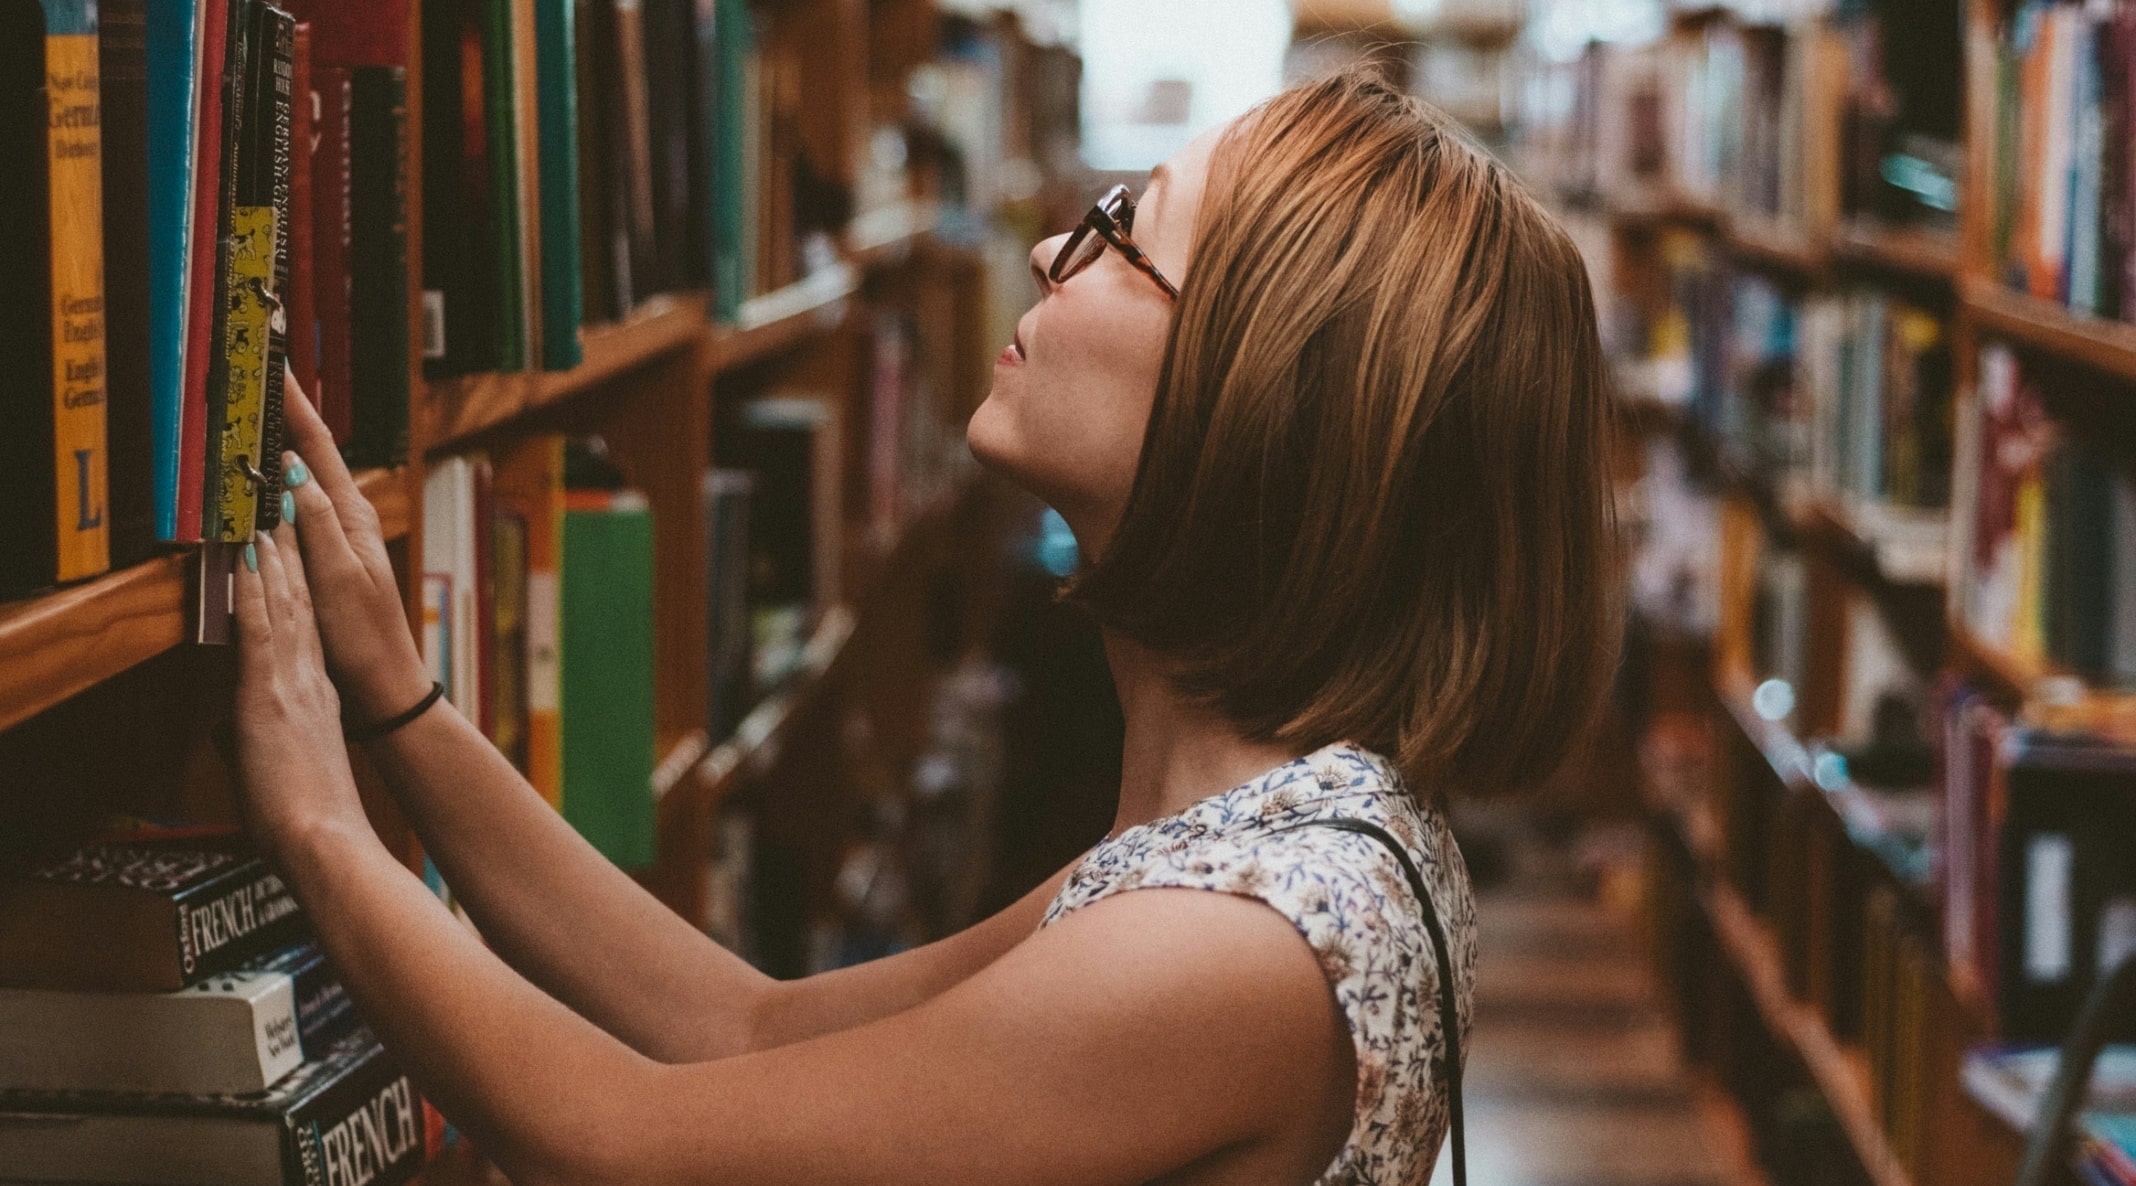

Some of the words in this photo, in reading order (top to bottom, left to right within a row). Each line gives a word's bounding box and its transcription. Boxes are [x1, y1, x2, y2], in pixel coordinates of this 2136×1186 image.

[280, 102, 290, 260] GERMAN-ENGLISH
[74, 449, 102, 531] L
[179, 904, 194, 974] Oxford
[191, 886, 257, 957] FRENCH
[321, 1075, 417, 1186] FRENCH
